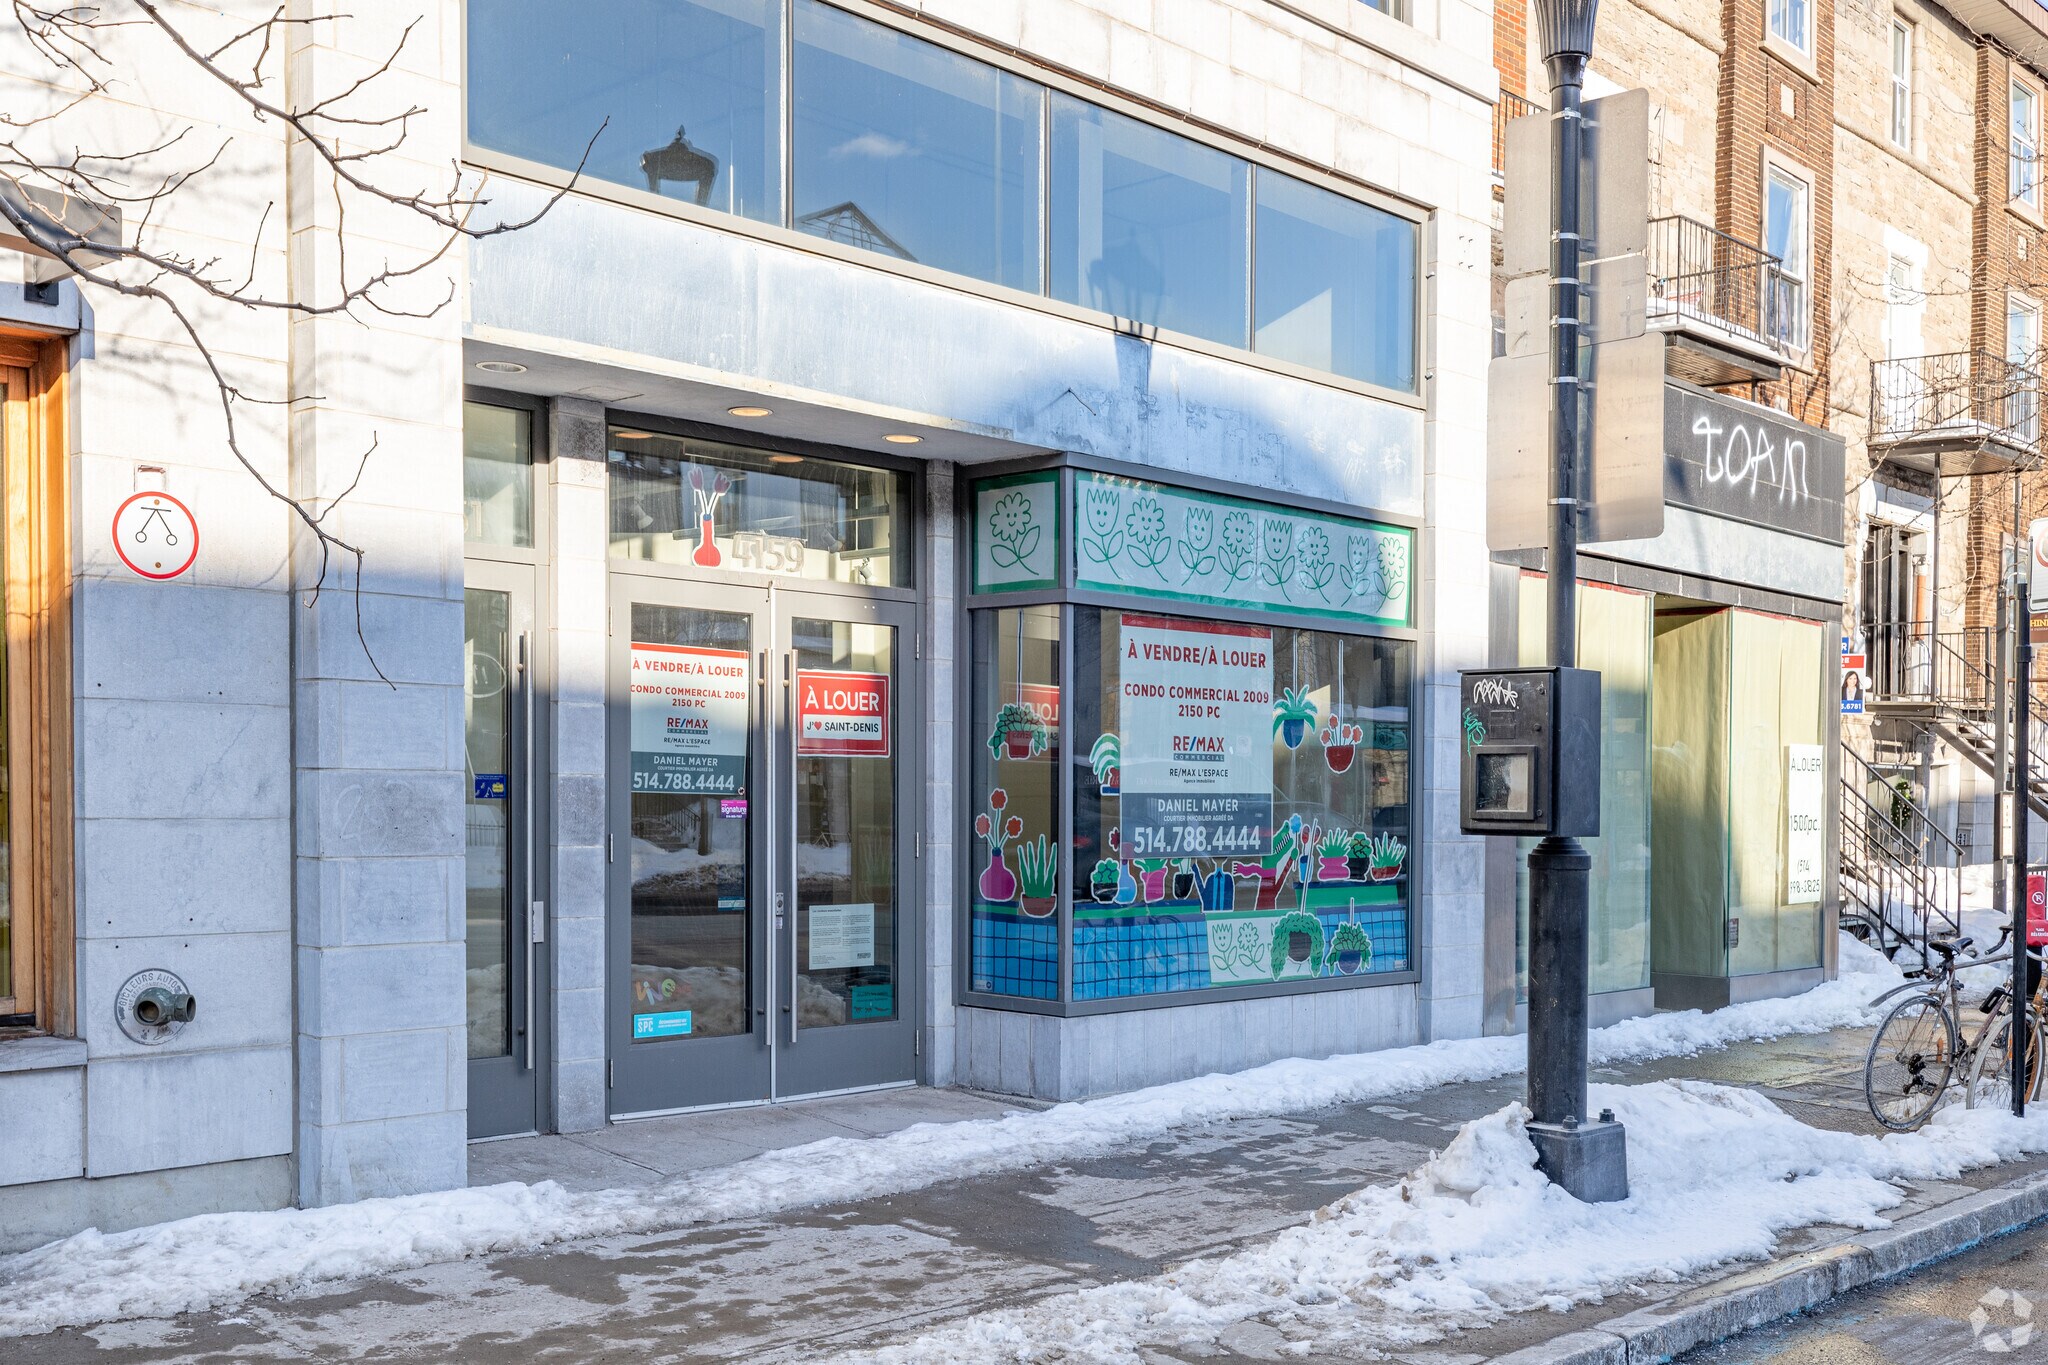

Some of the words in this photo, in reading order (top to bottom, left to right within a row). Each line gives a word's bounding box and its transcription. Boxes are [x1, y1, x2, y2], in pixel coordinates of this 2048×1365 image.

[731, 531, 805, 572] 4159
[1128, 638, 1138, 659] À
[1143, 643, 1217, 666] VENDRE/À
[1223, 650, 1266, 668] LOUER
[633, 657, 640, 670] À
[645, 660, 704, 675] VENDRE/À
[708, 665, 743, 677] LOUER
[630, 684, 662, 694] CONDO
[665, 687, 721, 698] COMMERCIAL
[724, 691, 746, 700] 2009
[805, 685, 819, 709] À
[824, 690, 879, 711] LOUER
[1124, 683, 1165, 698] CONDO
[1169, 686, 1239, 702] COMMERCIAL
[1243, 690, 1269, 704] 2009
[672, 698, 692, 707] 2150
[695, 700, 706, 708] PC
[1178, 704, 1203, 718] 2150
[1207, 706, 1220, 718] PC
[667, 717, 708, 729] RE/MAX
[825, 722, 879, 733] SAINT-DENIS
[1173, 735, 1225, 752] RE/MAX
[653, 755, 686, 765] DANIEL
[689, 757, 718, 766] MAYER
[1169, 768, 1196, 777] RE/MAX
[1197, 769, 1229, 777] L'ESPACE
[633, 772, 735, 791] 514.788.4444
[1158, 798, 1198, 812] DANIEL
[1202, 798, 1239, 812] MAYER
[1187, 814, 1212, 822] IMMOBILIER
[1134, 825, 1261, 854] 514.788.4444
[637, 1020, 654, 1033] SPC
